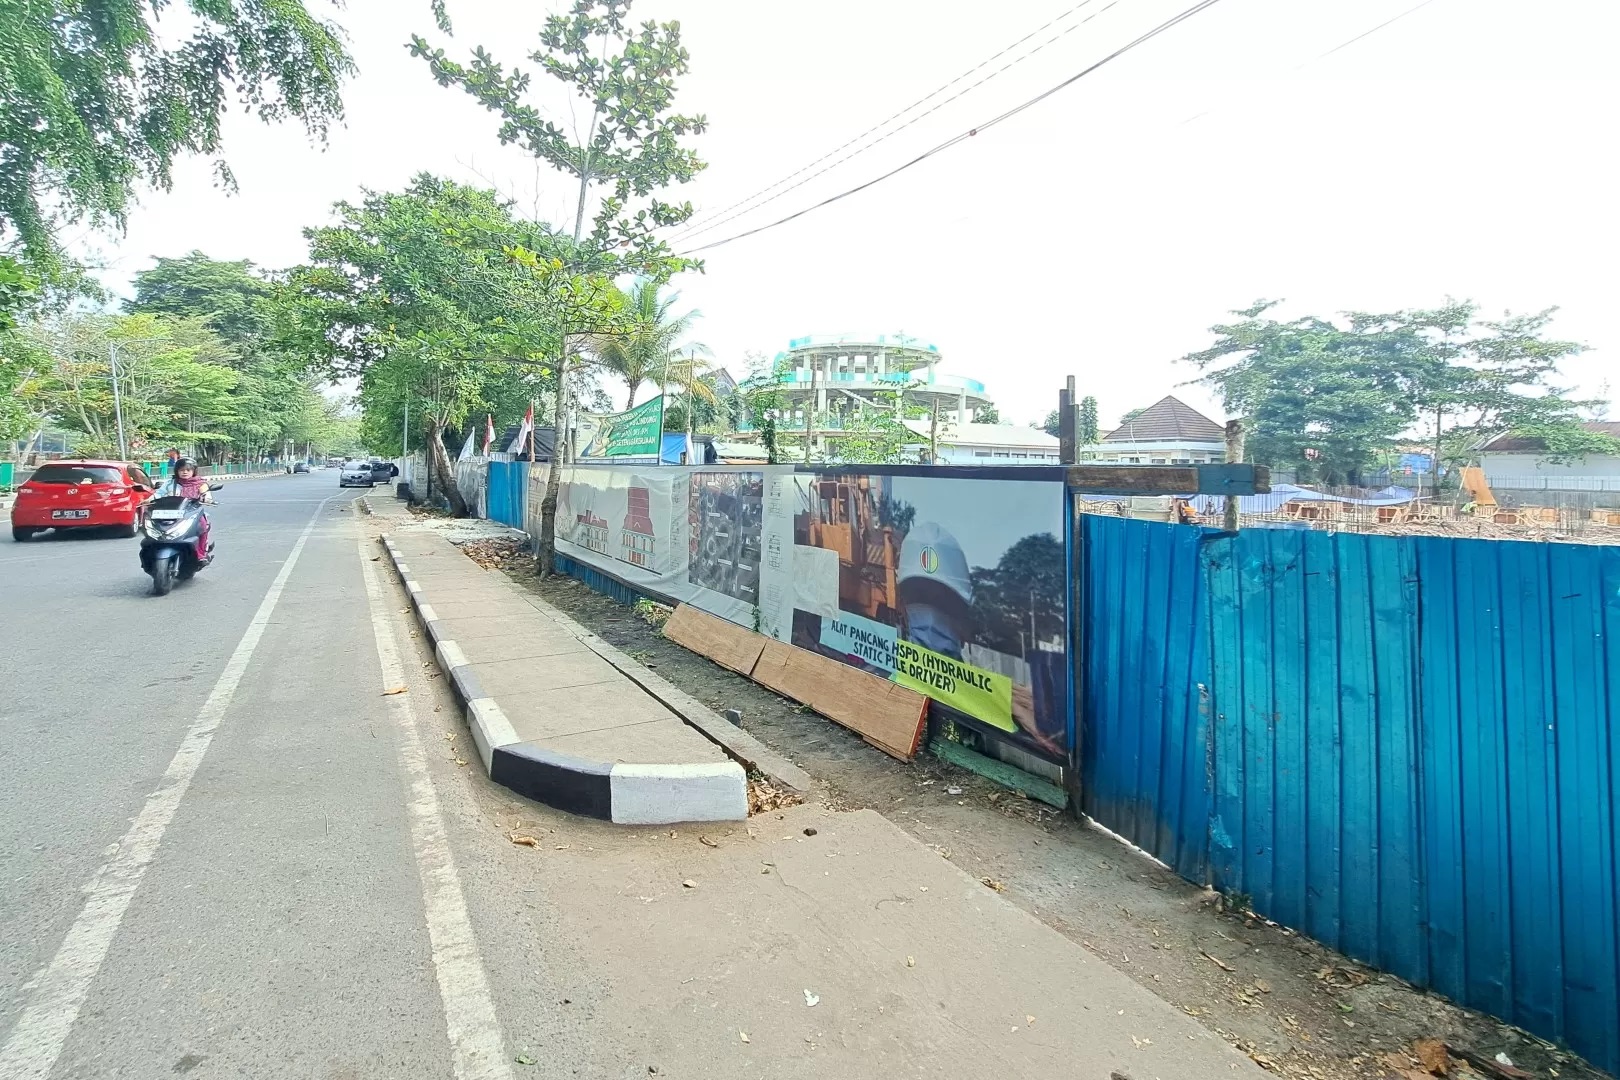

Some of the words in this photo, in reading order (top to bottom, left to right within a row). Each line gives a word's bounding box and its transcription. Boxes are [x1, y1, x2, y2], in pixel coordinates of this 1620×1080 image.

[831, 620, 848, 636] ALAT
[849, 626, 889, 652] PANCANG
[892, 642, 919, 662] HSPD
[922, 653, 993, 693] (HYDRAULIC
[853, 642, 883, 664] STATIC
[885, 653, 907, 674] PILE
[909, 664, 956, 694] DRIVER)
